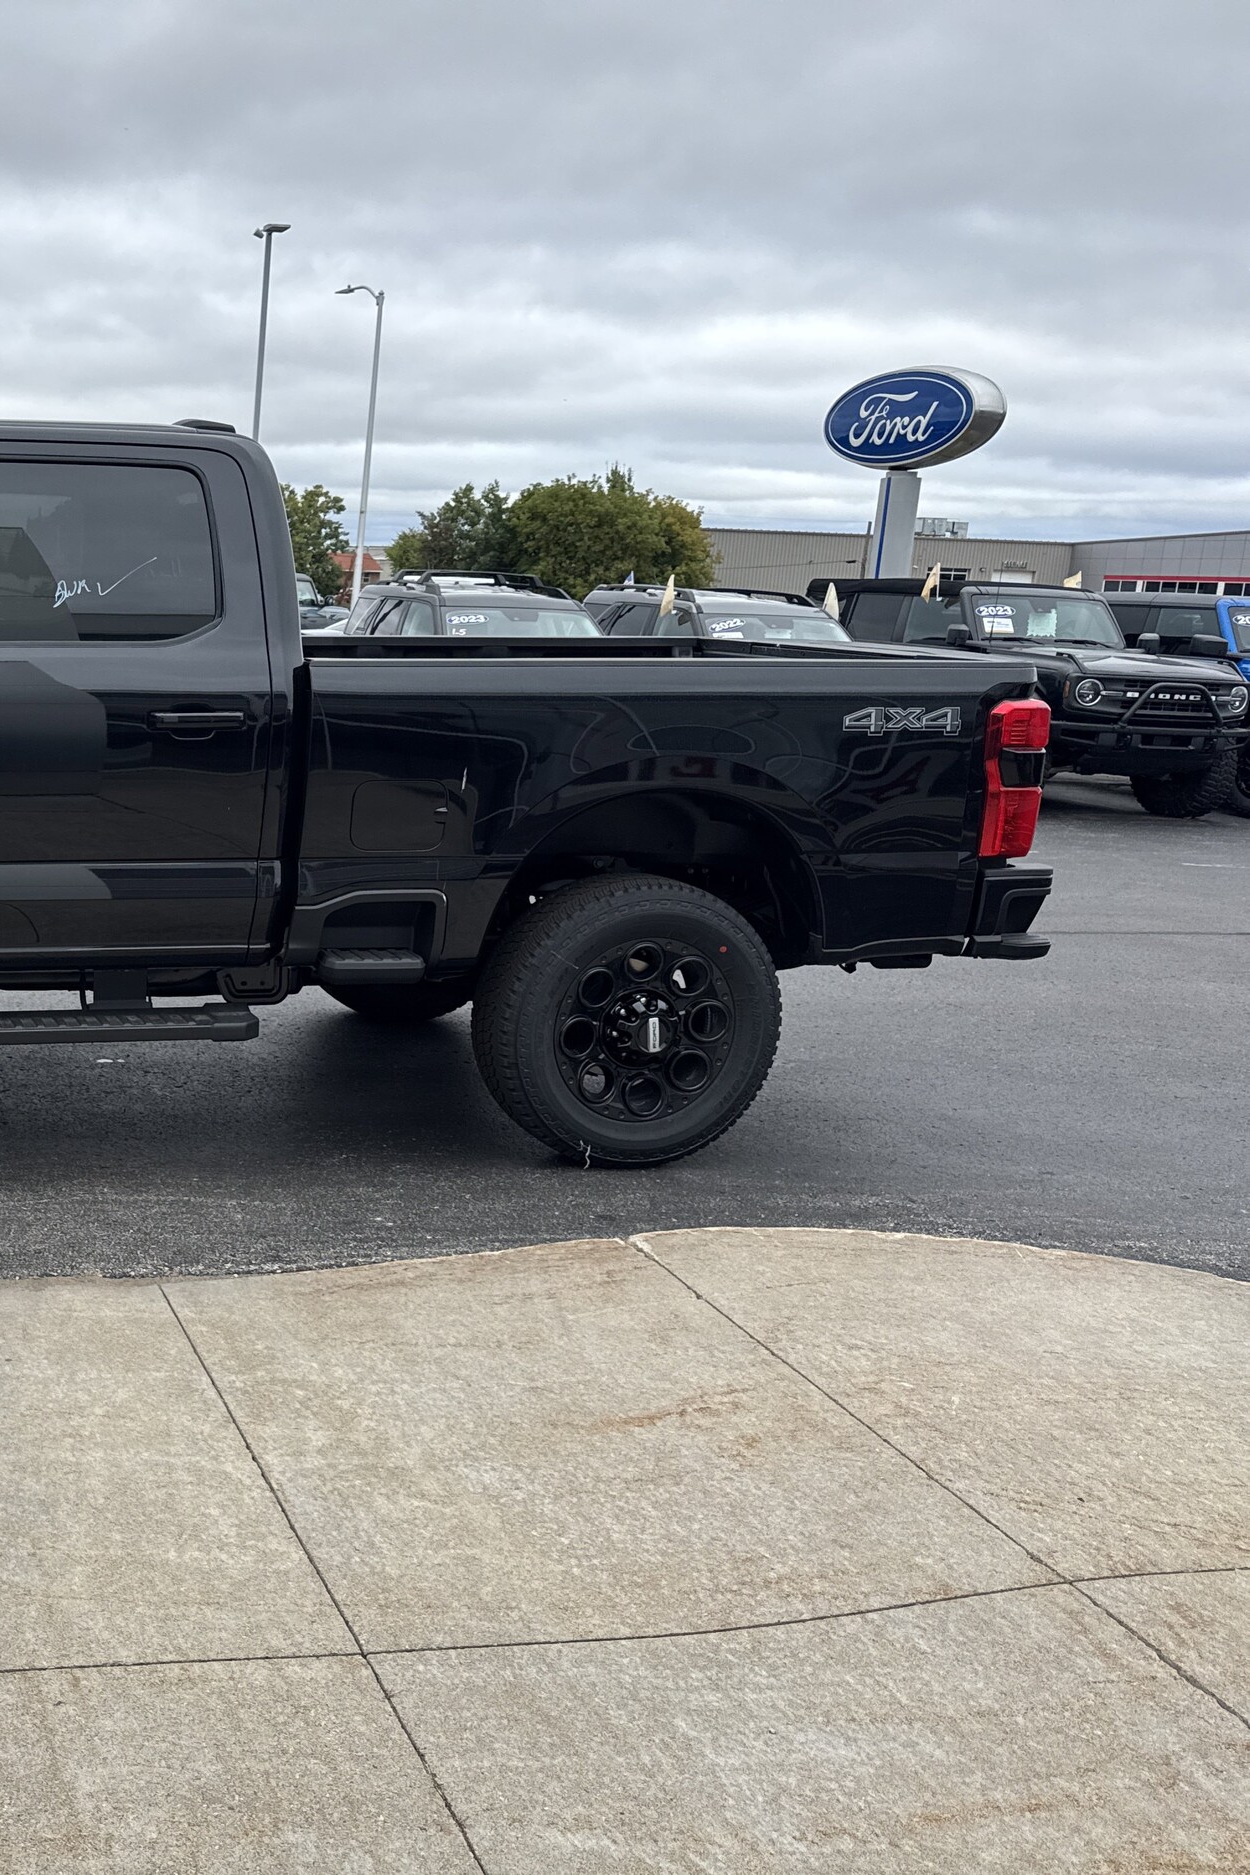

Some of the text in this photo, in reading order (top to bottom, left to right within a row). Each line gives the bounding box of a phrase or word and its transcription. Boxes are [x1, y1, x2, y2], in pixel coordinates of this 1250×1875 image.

[849, 390, 940, 448] Ford
[979, 606, 1013, 616] 2023
[451, 615, 486, 624] 2023
[711, 618, 745, 631] 2022
